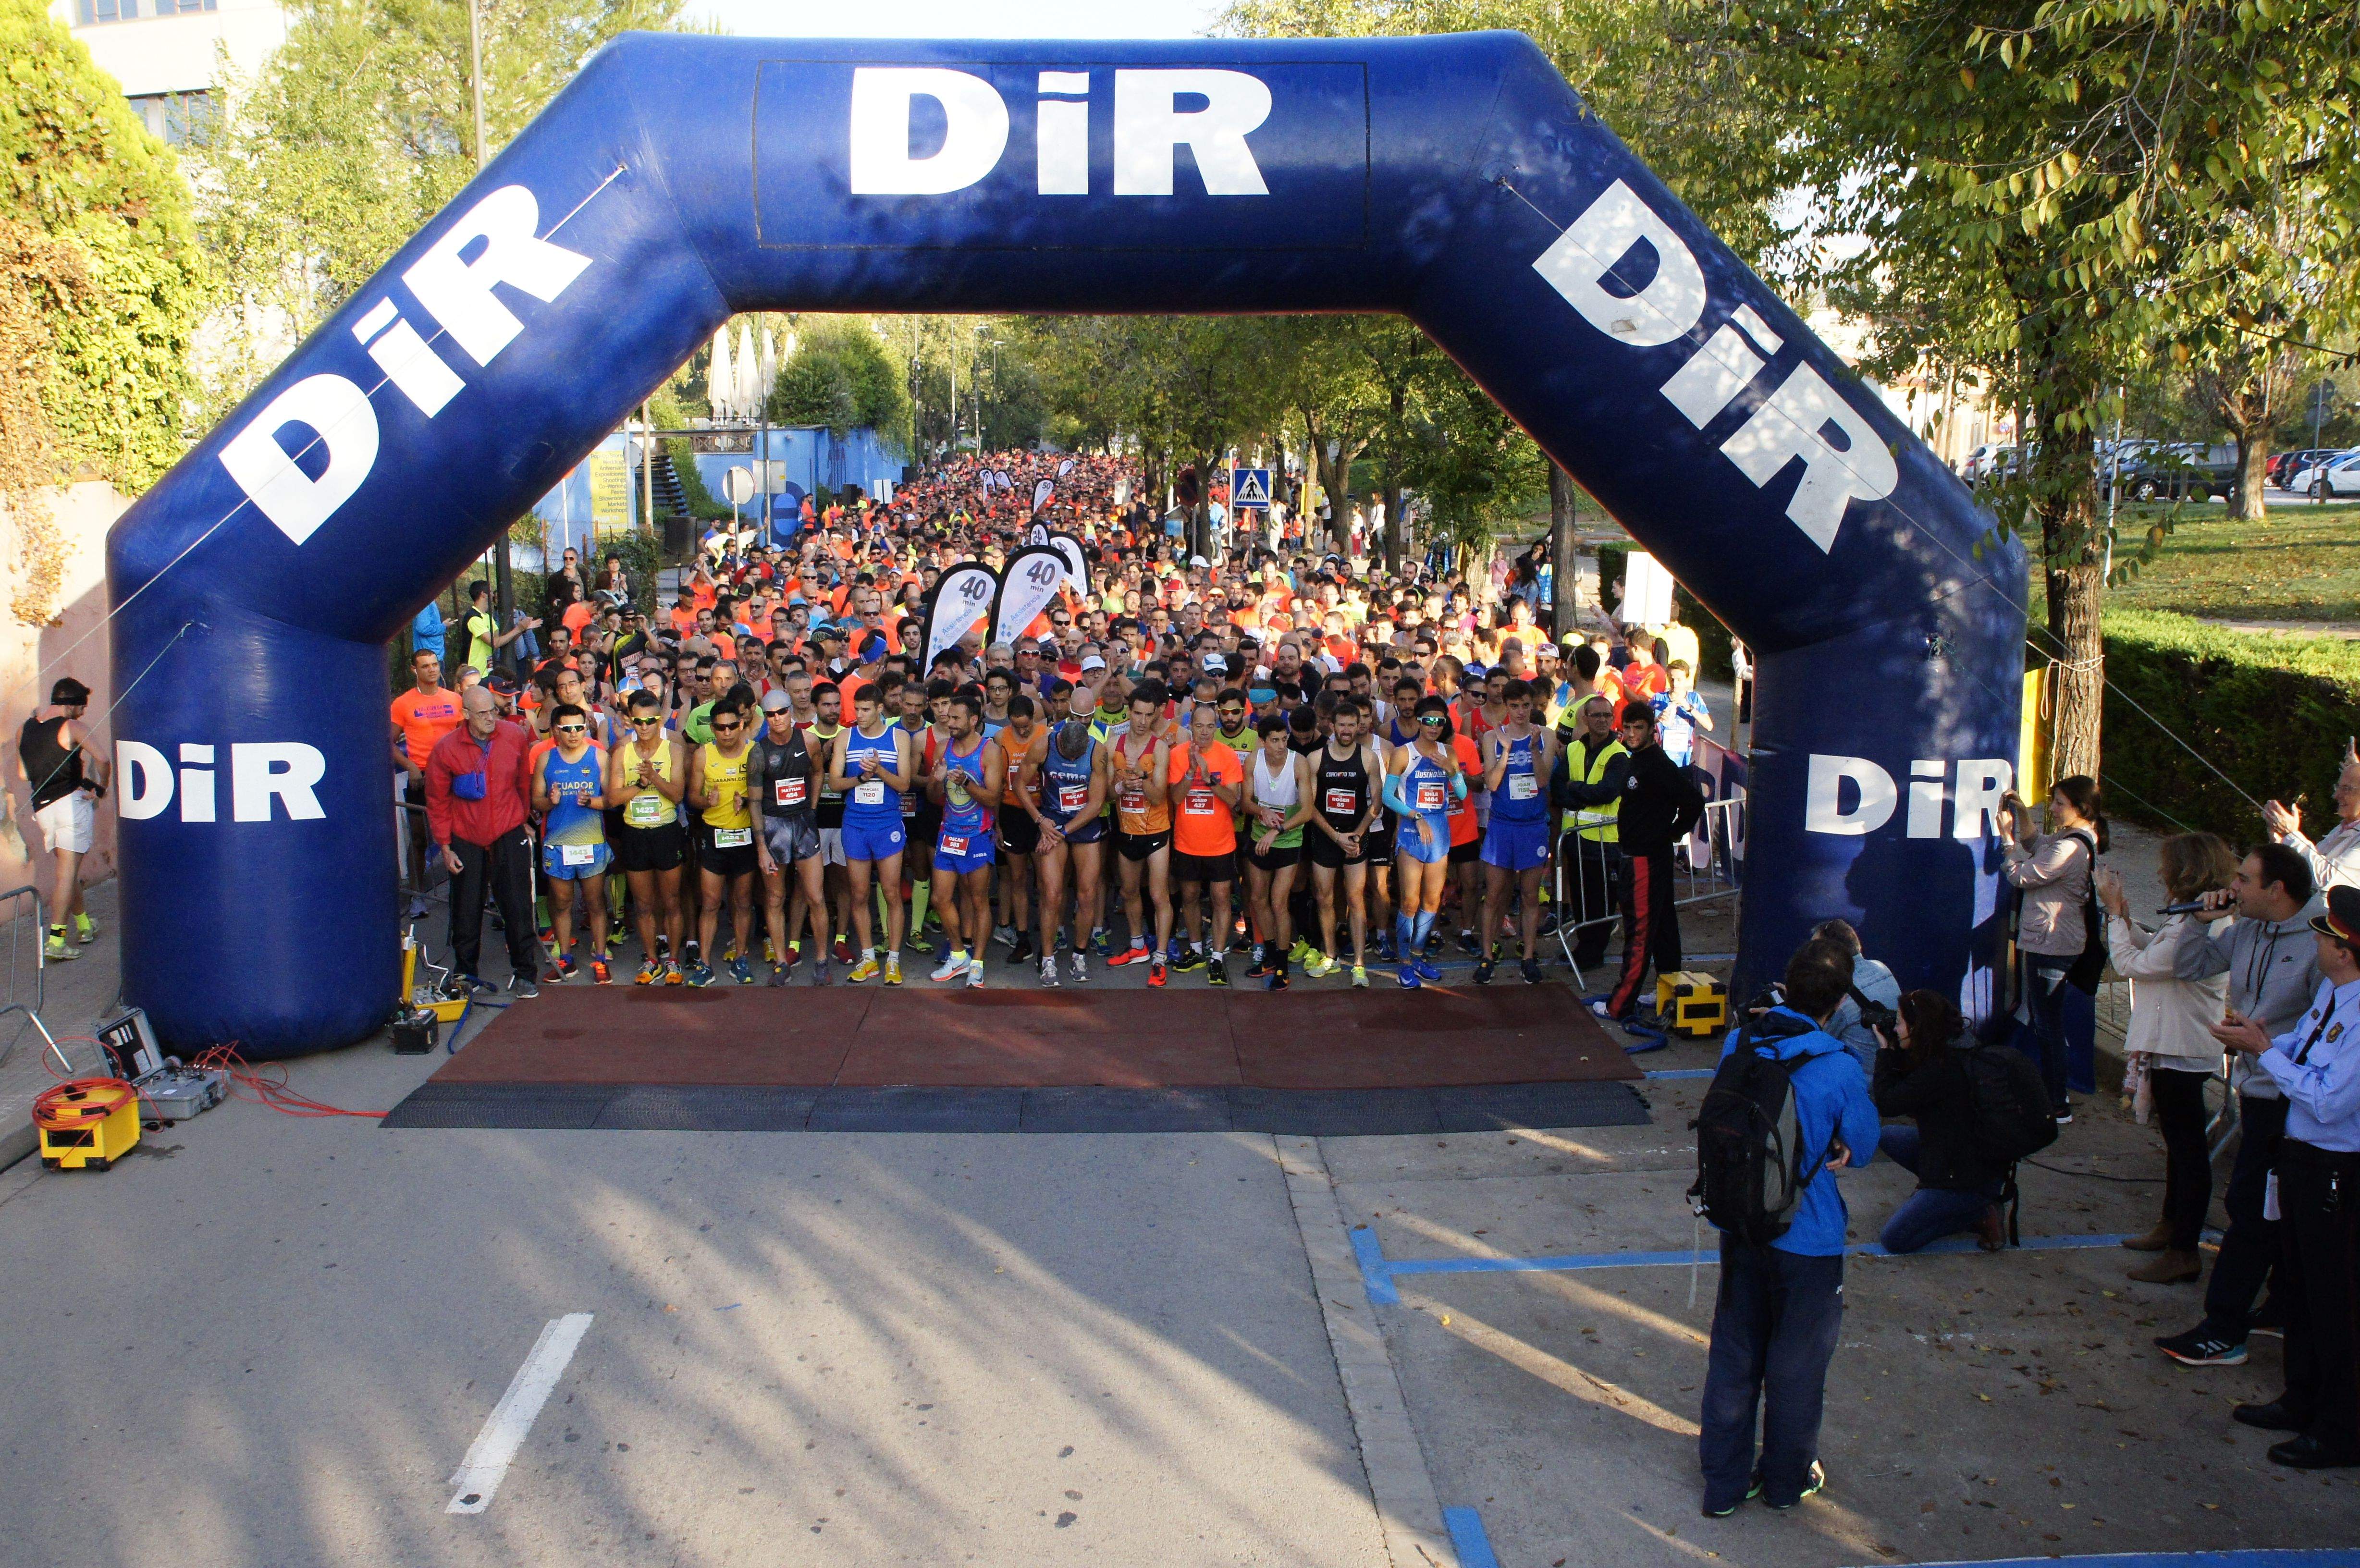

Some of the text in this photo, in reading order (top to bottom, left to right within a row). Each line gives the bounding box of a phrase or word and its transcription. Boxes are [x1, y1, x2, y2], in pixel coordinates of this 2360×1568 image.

[850, 67, 1272, 196] DiR
[219, 185, 593, 546] DiR
[1532, 178, 1898, 555] DiR
[1042, 482, 1051, 490] 50
[959, 576, 986, 600] 40
[1027, 561, 1056, 586] 40
[1030, 584, 1044, 593] min
[116, 740, 327, 822] DiR
[1805, 754, 2012, 838] DiR
